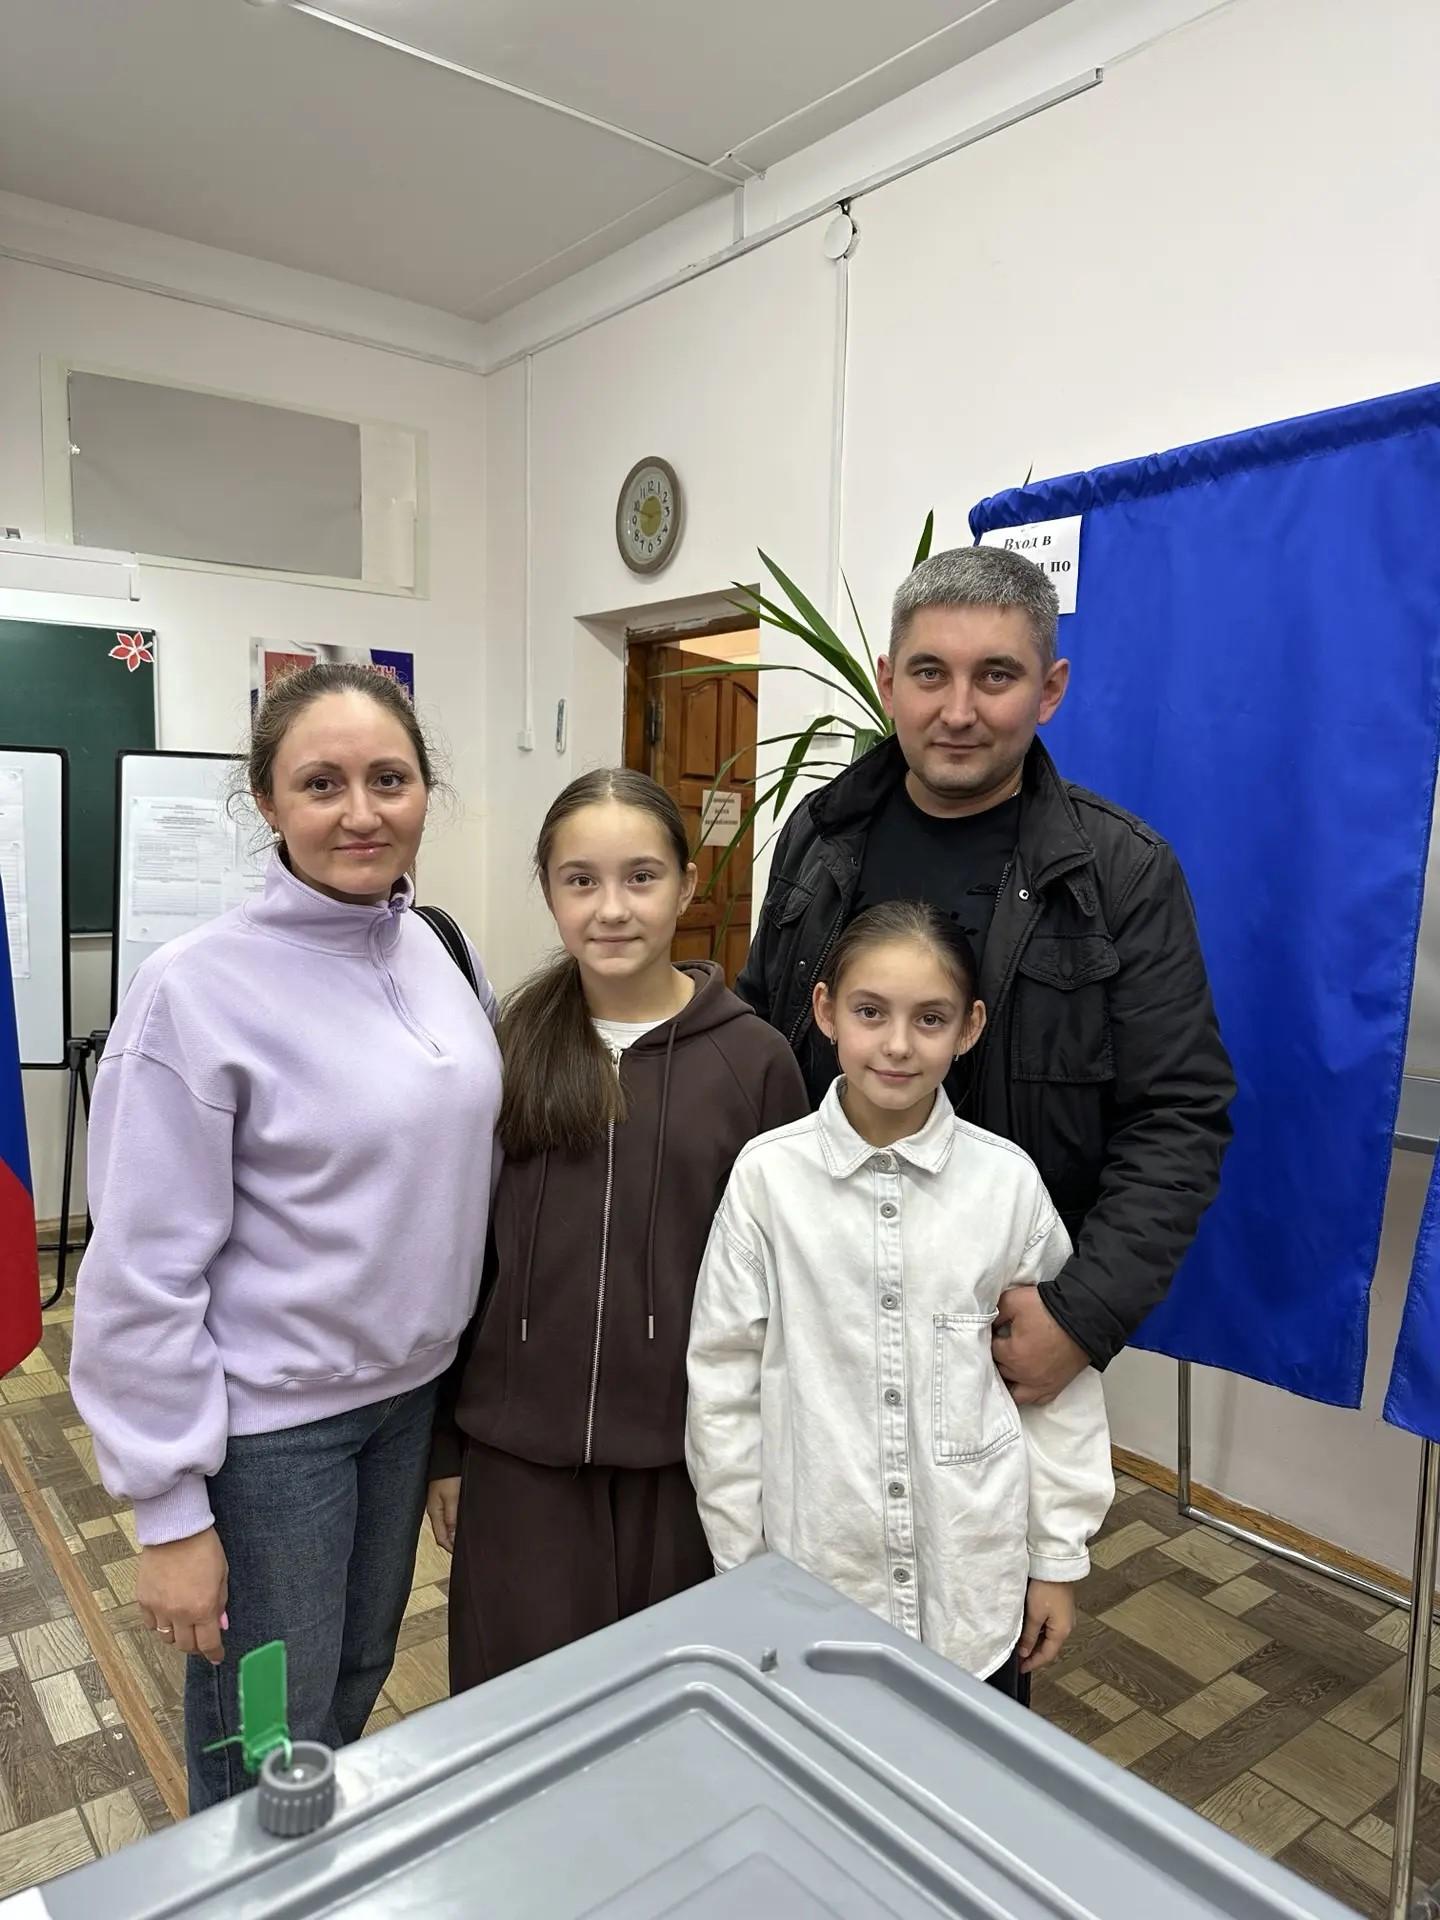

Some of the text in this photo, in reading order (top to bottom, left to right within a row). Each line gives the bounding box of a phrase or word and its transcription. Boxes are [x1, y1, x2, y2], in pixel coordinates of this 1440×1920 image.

[647, 480, 654, 493] 12
[662, 491, 668, 503] 2
[664, 506, 670, 518] 3
[634, 529, 640, 541] 8
[656, 535, 662, 546] 5
[640, 539, 645, 551] 7
[1003, 537, 1038, 550] Вход
